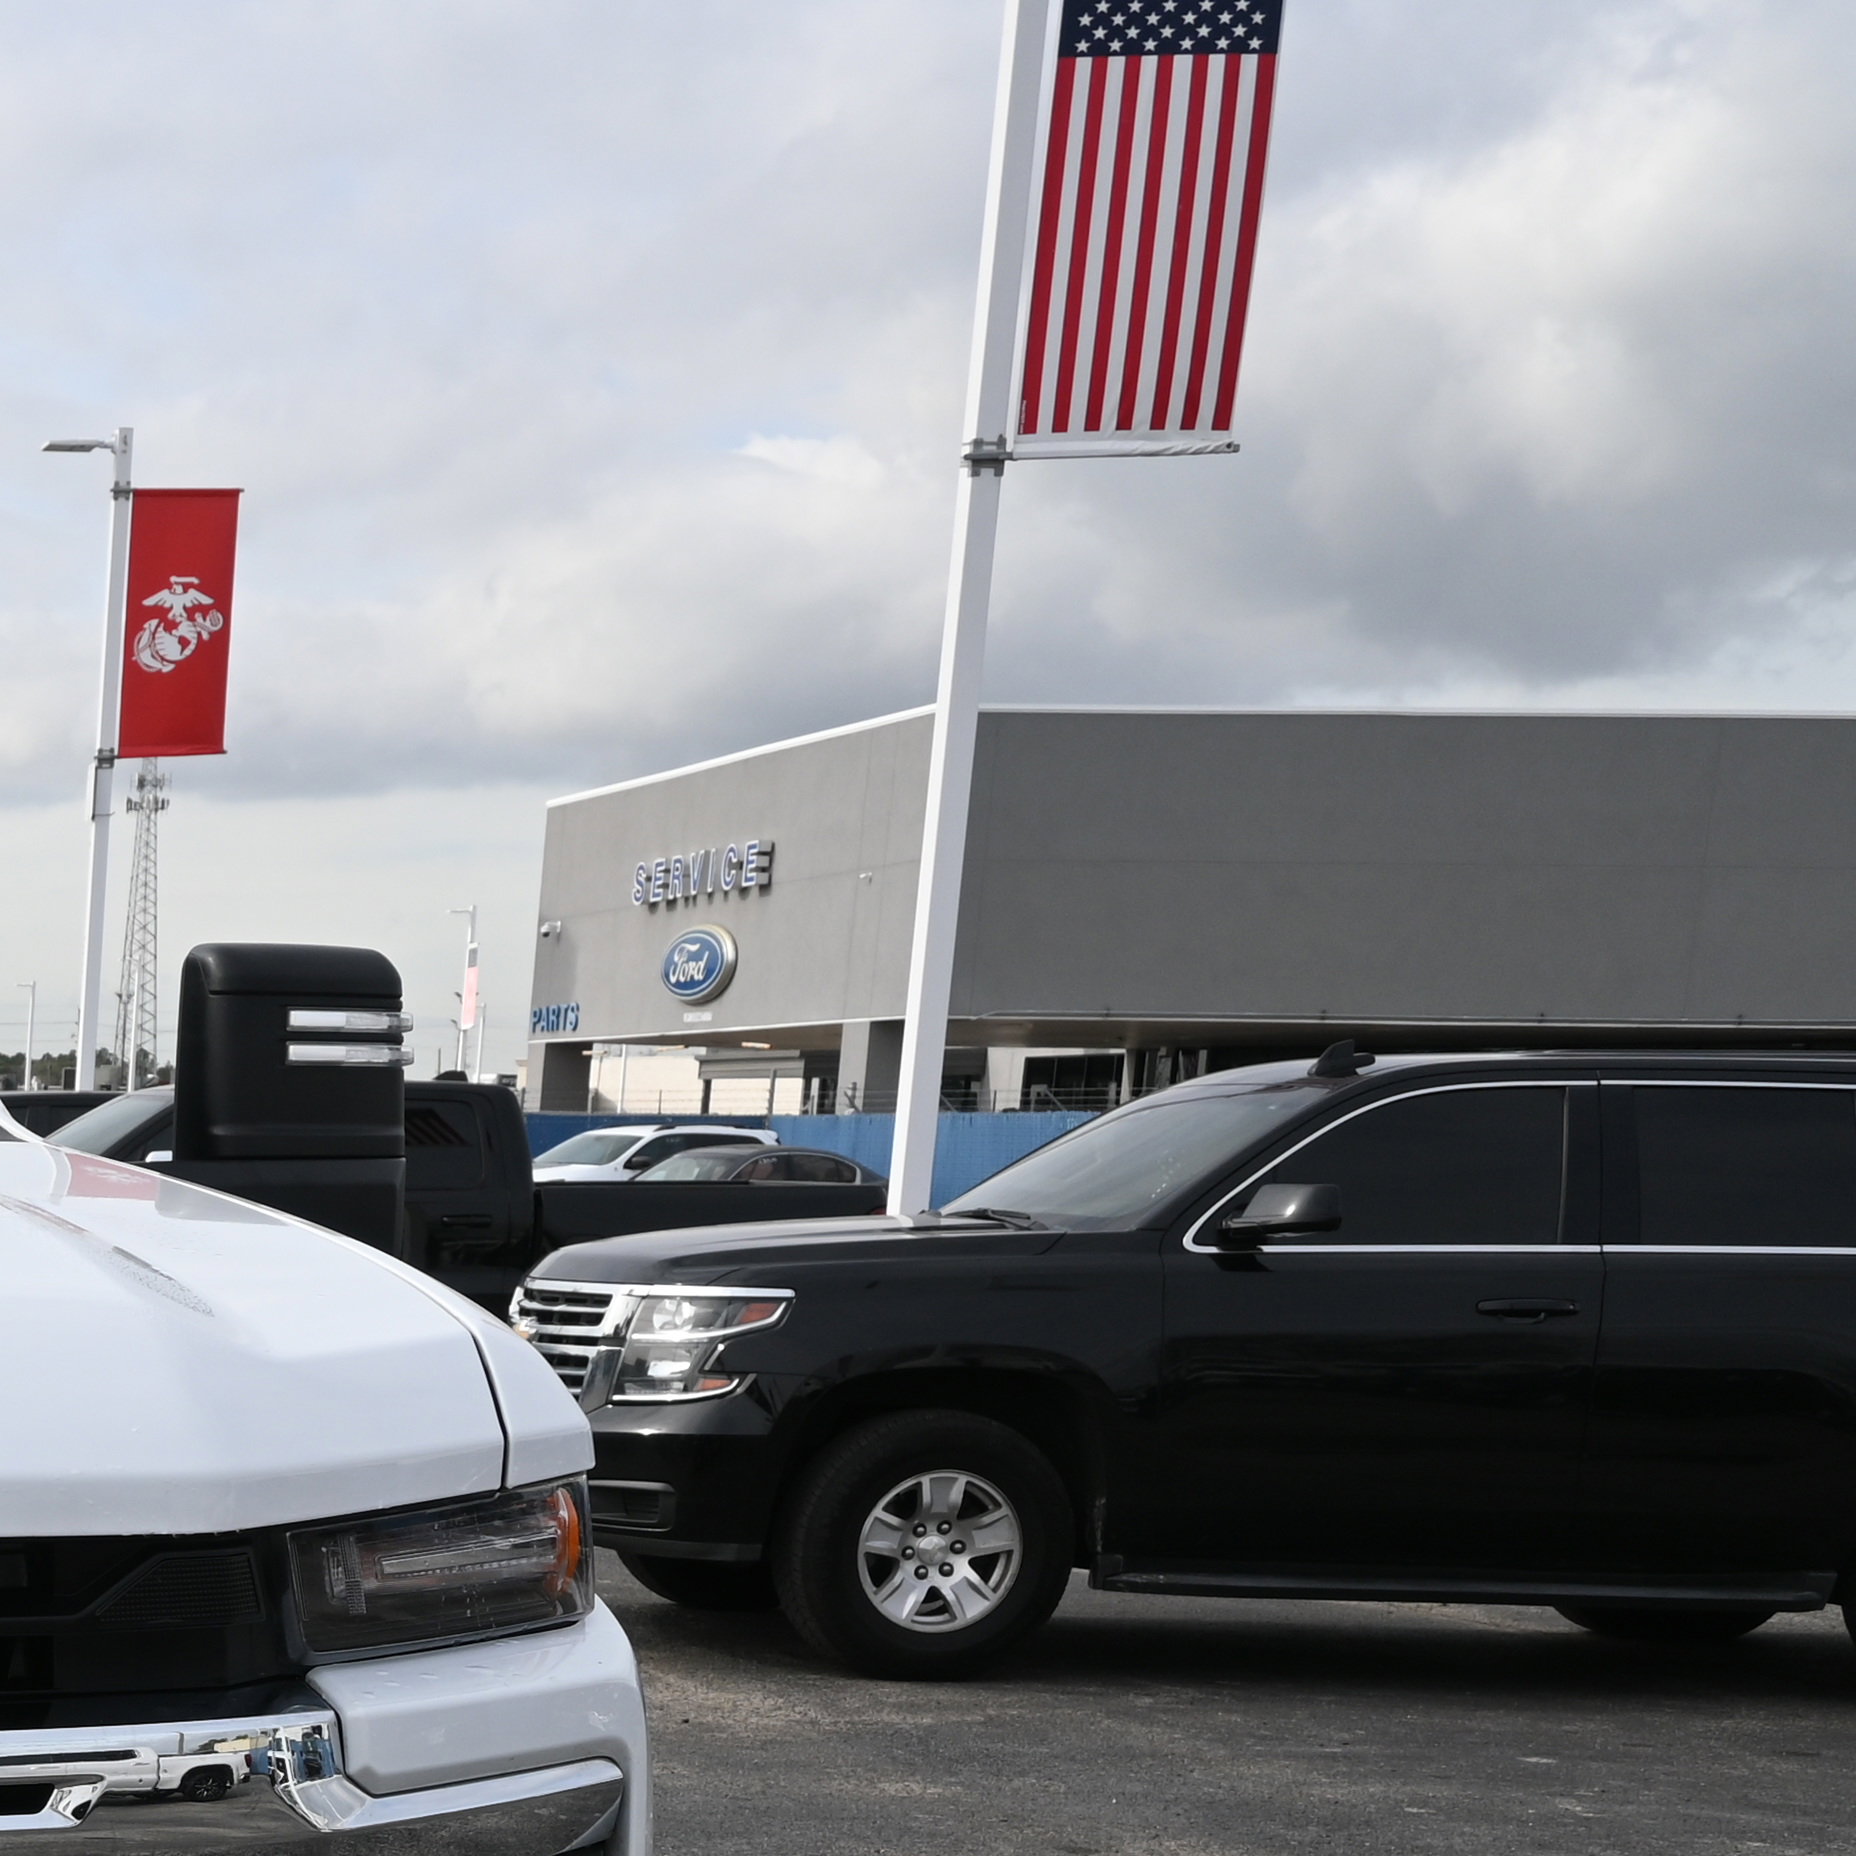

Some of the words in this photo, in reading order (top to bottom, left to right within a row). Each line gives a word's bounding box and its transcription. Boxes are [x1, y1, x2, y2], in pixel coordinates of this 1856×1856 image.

[631, 839, 761, 906] SERVICE
[668, 942, 710, 984] Ford
[531, 1001, 580, 1035] PARTS
